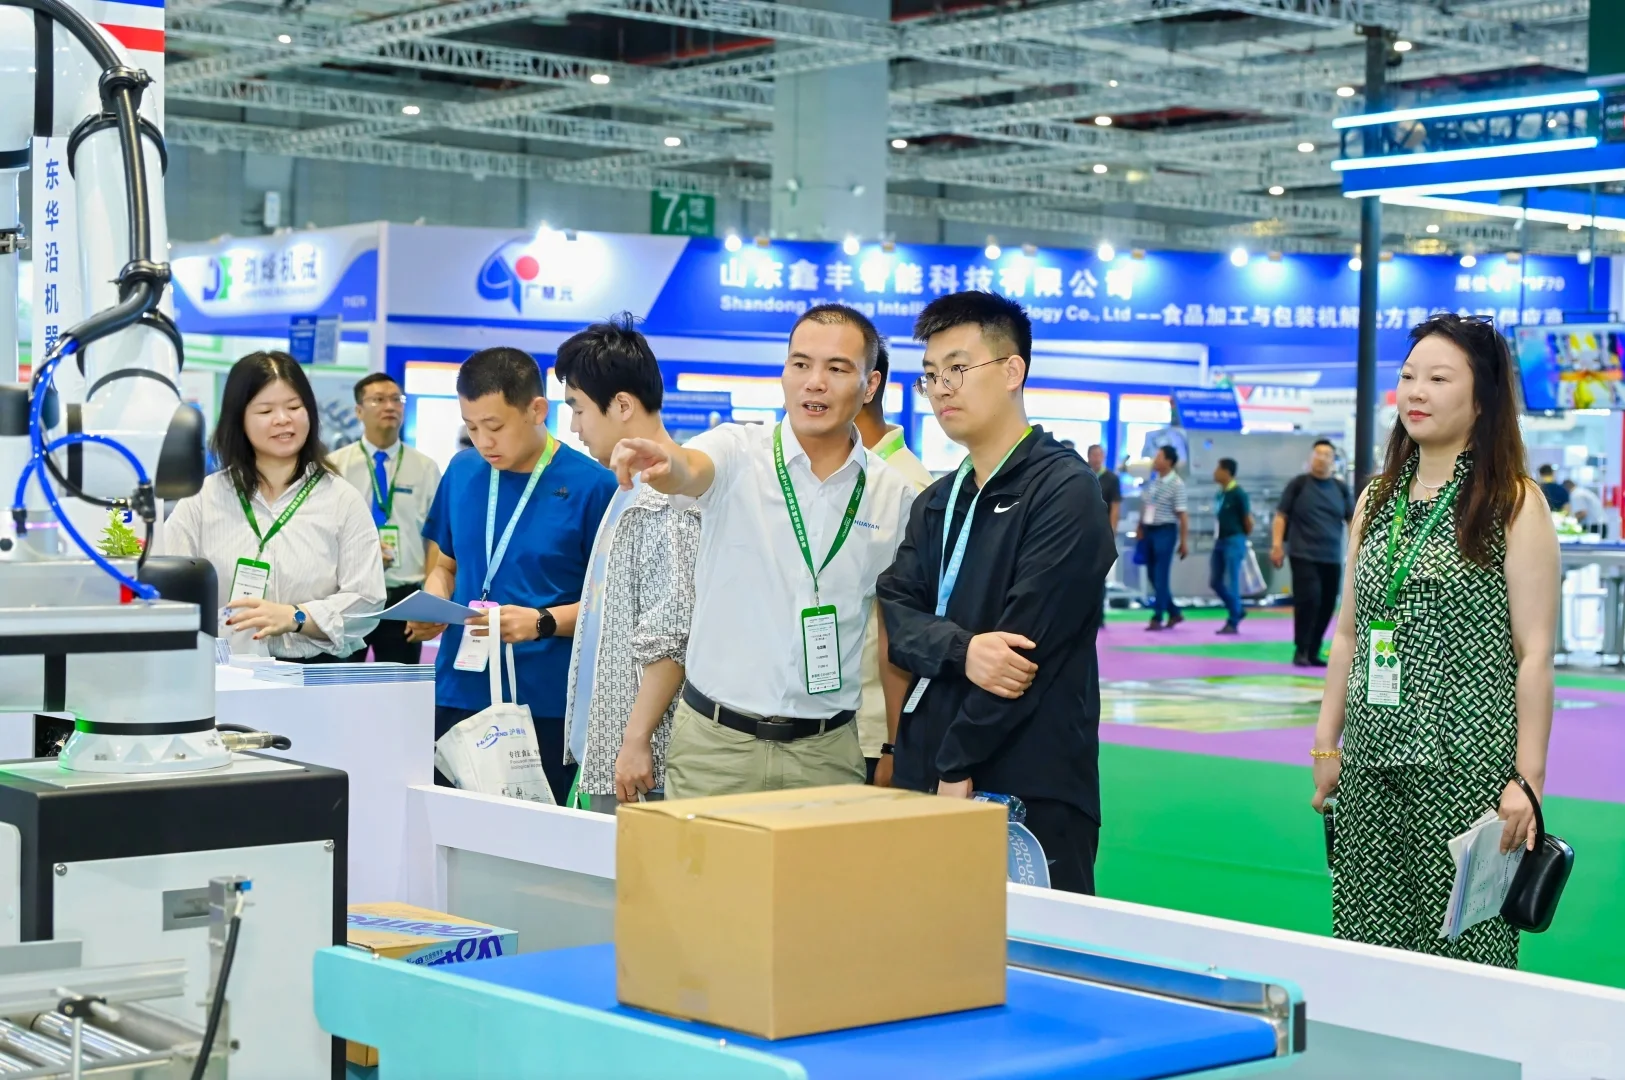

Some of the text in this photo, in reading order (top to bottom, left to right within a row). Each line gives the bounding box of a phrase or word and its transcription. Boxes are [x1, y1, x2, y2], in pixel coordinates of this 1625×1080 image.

[45, 137, 60, 393] 东华沿机器人
[720, 294, 806, 316] Shandong
[1103, 306, 1131, 322] Ltd
[854, 519, 880, 530] HUAYAN
[1007, 834, 1028, 886] ATALOG
[1008, 829, 1036, 886] PRODUC
